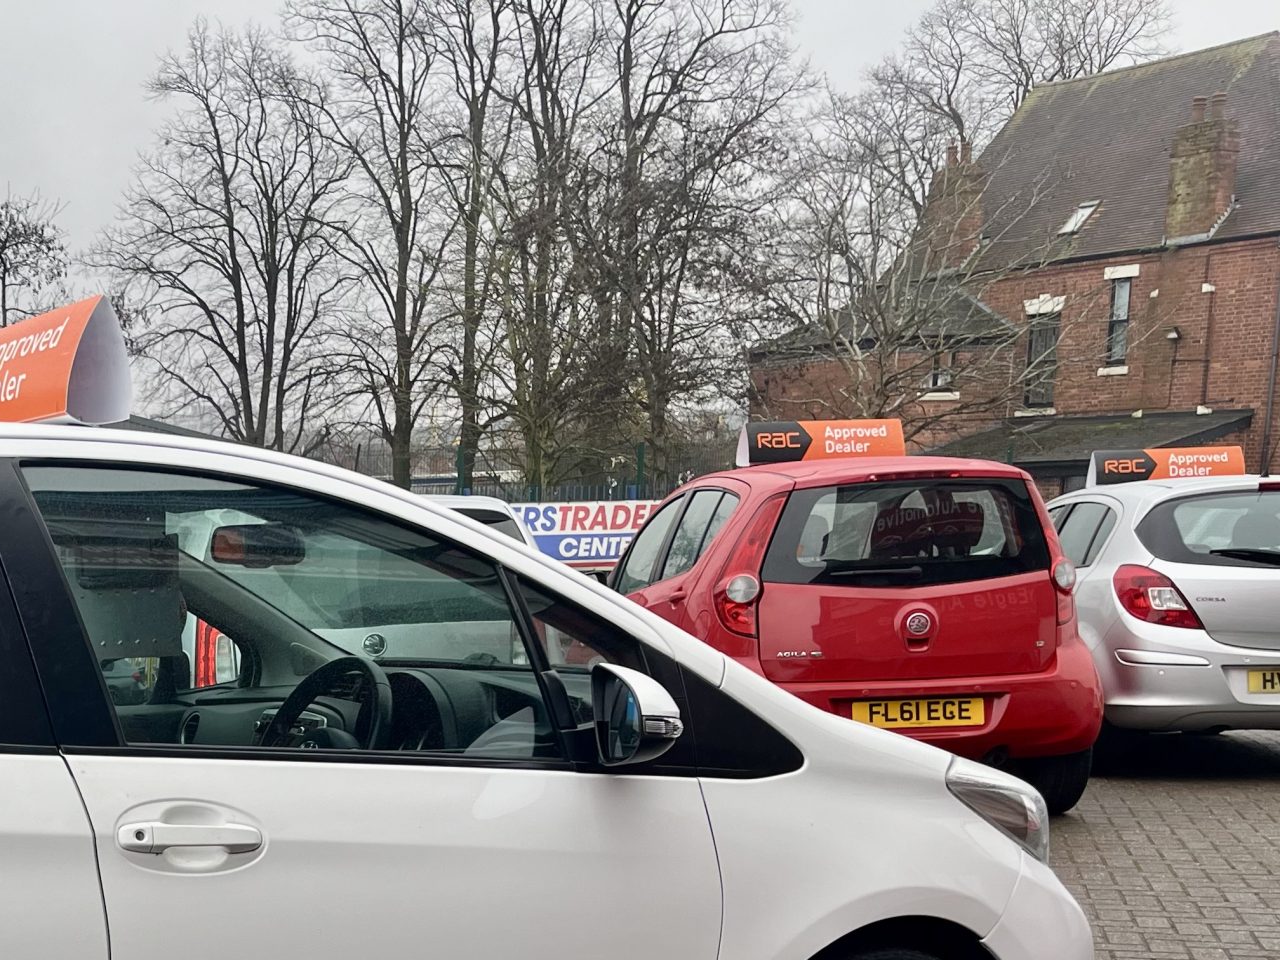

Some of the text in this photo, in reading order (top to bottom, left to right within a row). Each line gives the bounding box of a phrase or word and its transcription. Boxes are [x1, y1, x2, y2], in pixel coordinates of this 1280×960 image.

[824, 425, 887, 439] Approved
[824, 440, 871, 453] Dealer
[1168, 452, 1229, 466] Approved
[1168, 466, 1213, 477] Dealer
[1262, 672, 1280, 690] H
[869, 700, 972, 722] FL61 EGE
